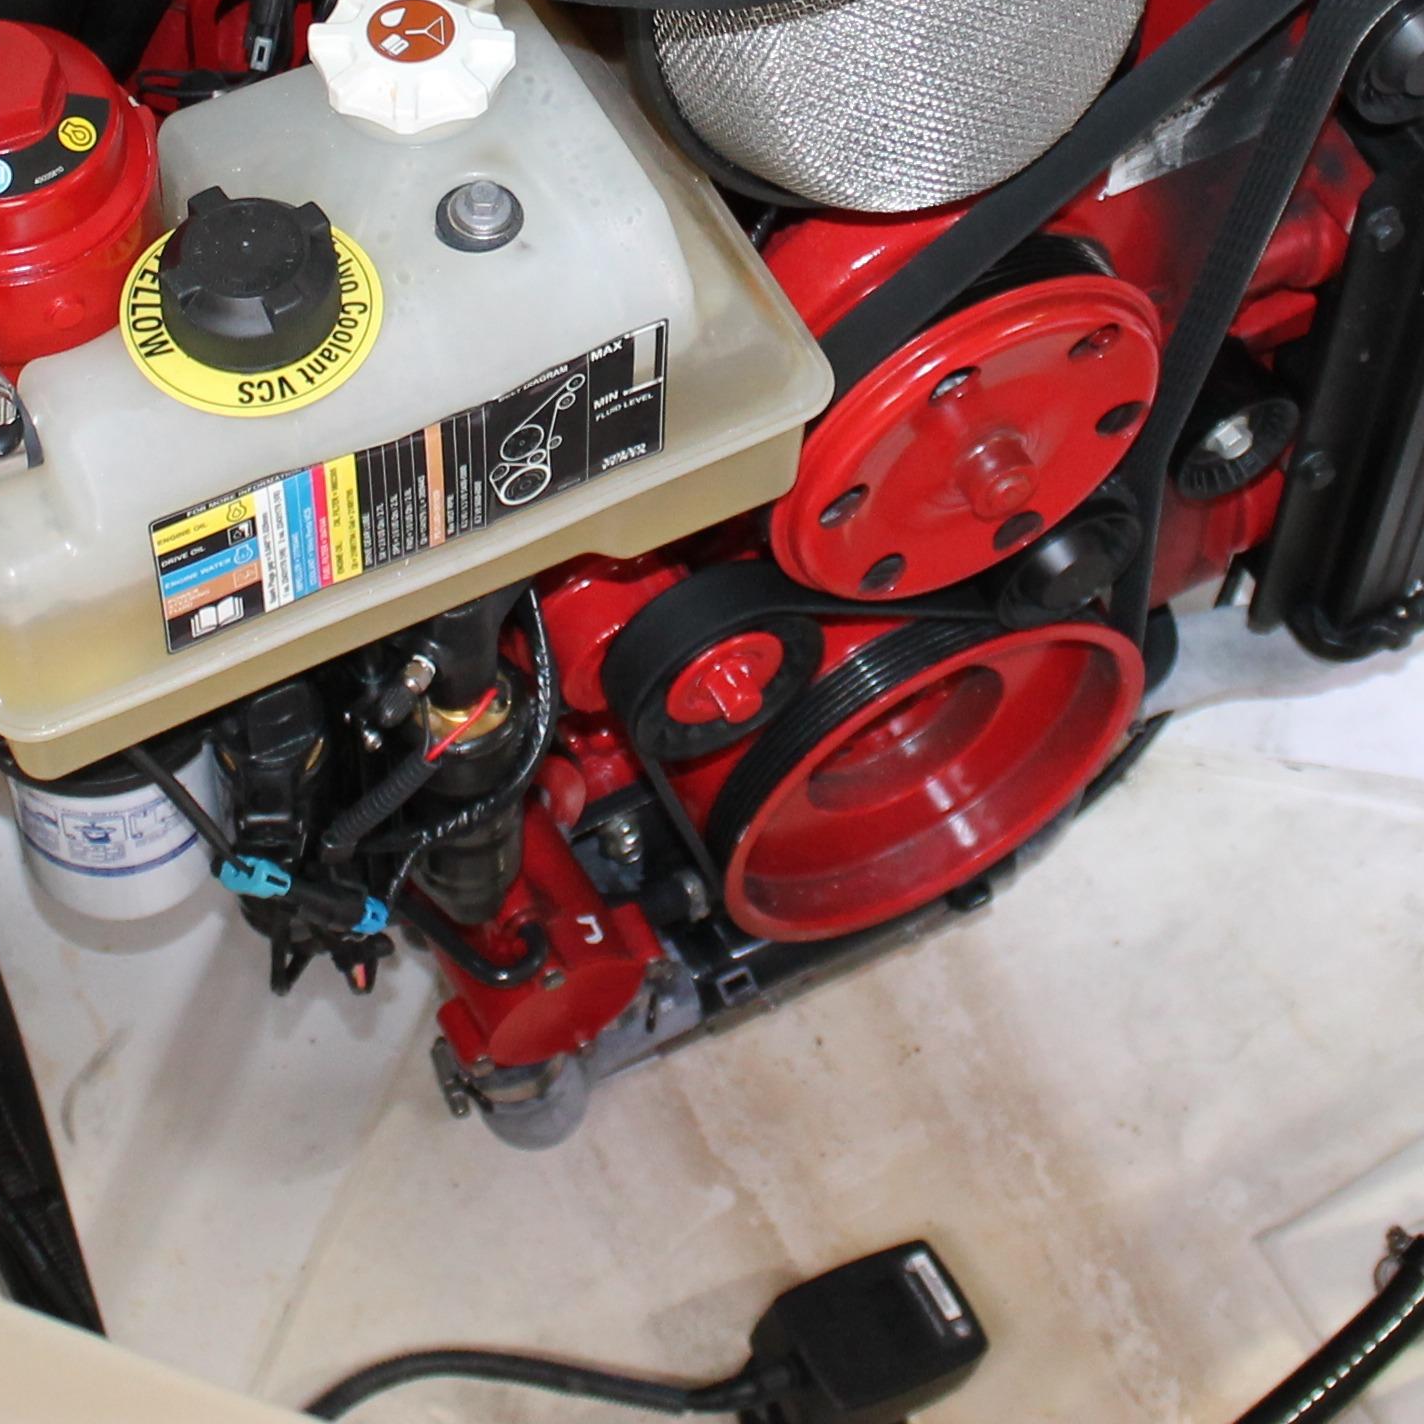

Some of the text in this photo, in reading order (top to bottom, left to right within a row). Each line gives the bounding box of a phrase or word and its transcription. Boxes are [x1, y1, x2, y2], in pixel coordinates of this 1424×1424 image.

[130, 252, 175, 359] ELLOW
[295, 301, 369, 386] Coolant
[590, 340, 623, 363] MAX
[237, 377, 297, 404] VCS
[523, 364, 570, 391] DIAGRAM
[593, 390, 619, 411] MIN
[594, 392, 654, 423] FLUID LEVEL
[186, 504, 207, 518] FOR
[208, 494, 236, 510] MORE
[157, 521, 208, 546] ENGINE OIL
[161, 546, 206, 569] DRIVE OIL
[164, 557, 233, 590] ENGINE WATER
